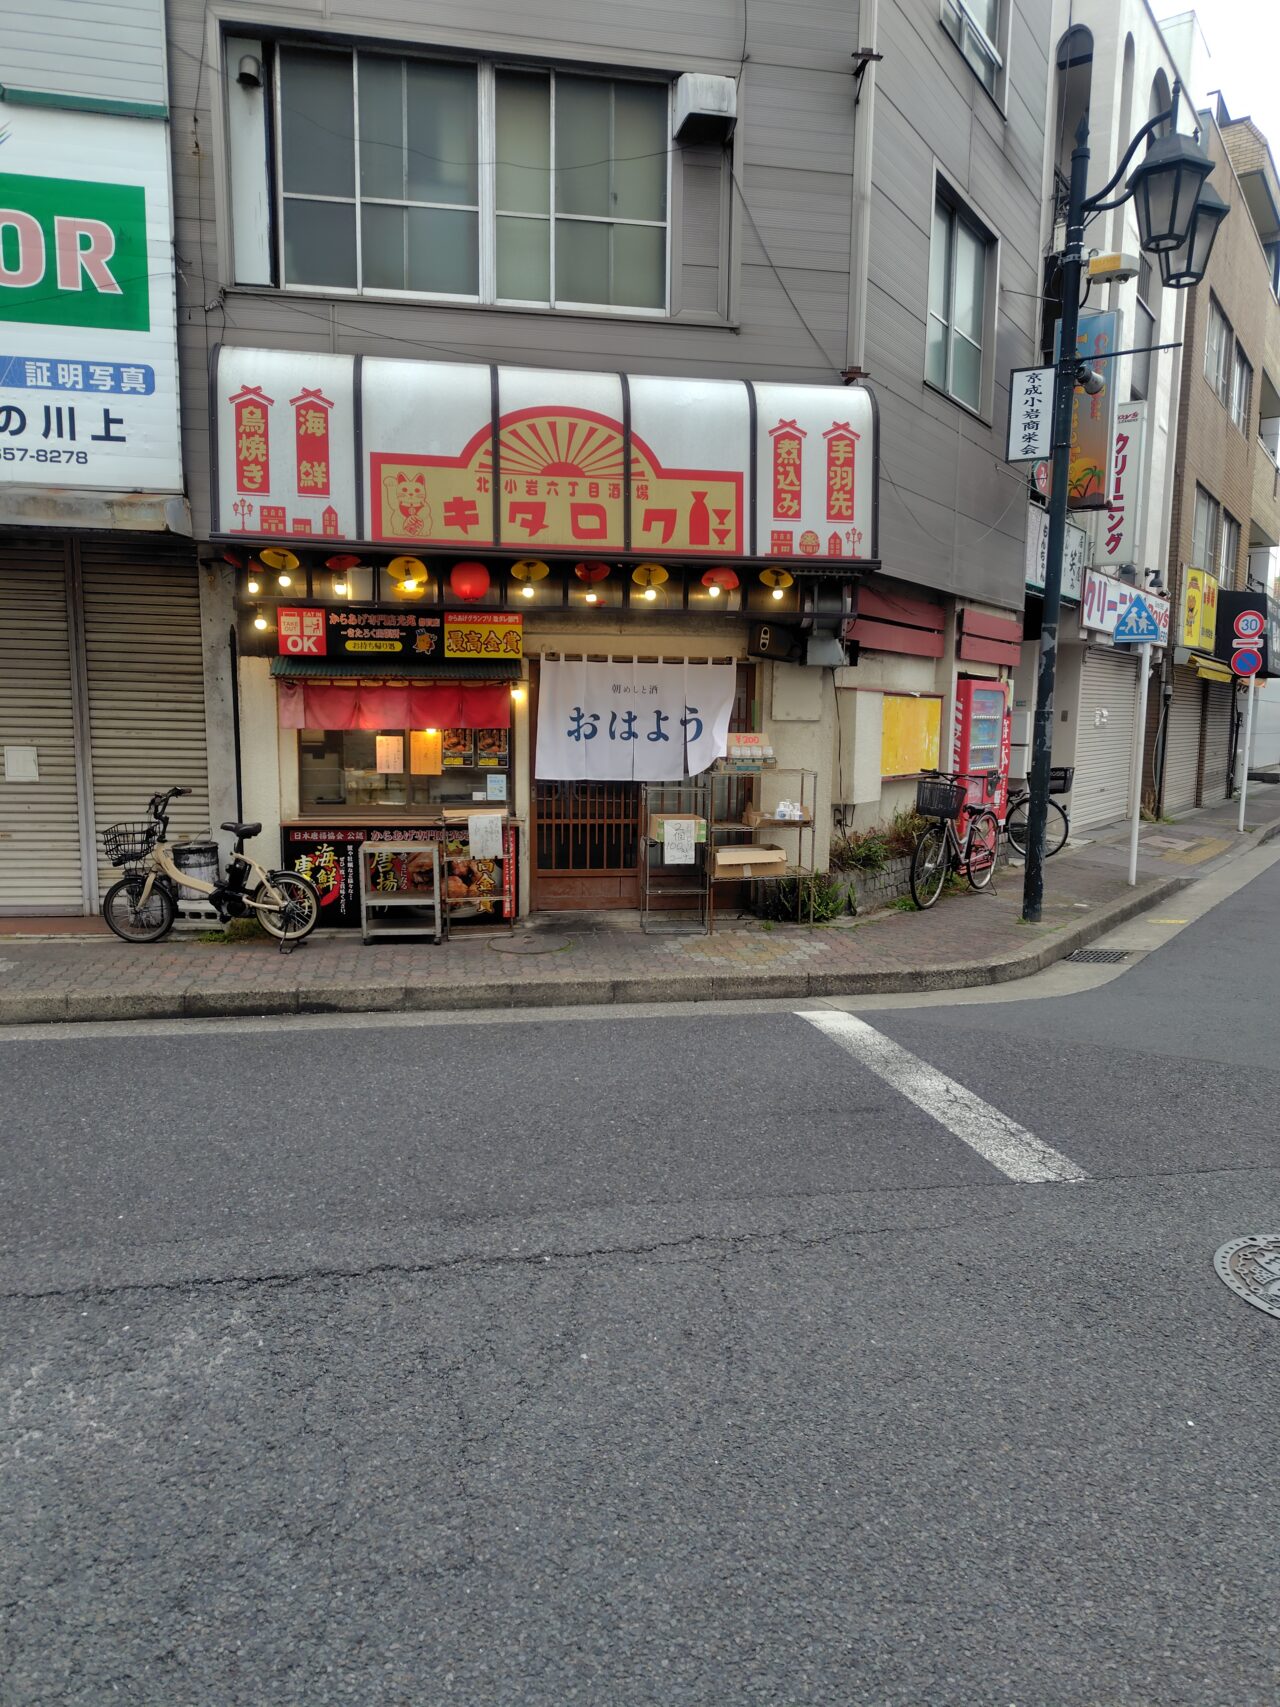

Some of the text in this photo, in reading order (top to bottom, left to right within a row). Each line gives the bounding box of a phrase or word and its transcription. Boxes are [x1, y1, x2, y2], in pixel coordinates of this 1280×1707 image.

[0, 208, 123, 295] OR
[25, 361, 146, 393] 証明写真
[0, 404, 127, 443] の川上
[1020, 373, 1042, 455] 京成小岩商栄会
[0, 447, 88, 465] 57-8278
[239, 406, 266, 489] 鳥焼き
[299, 409, 327, 489] 海鮮
[476, 476, 649, 500] 北小岩六丁目酒場
[777, 439, 800, 516] 煮込み
[829, 439, 854, 516] 手羽先
[1105, 433, 1129, 555] クリーニング
[443, 496, 678, 545] キタロク
[286, 636, 319, 652] OK
[447, 630, 521, 654] 最高金賞
[1241, 619, 1258, 631] 30
[612, 684, 658, 694] 朝めしと酒
[567, 706, 704, 745] おはよう
[315, 843, 338, 891] 海鮮
[475, 857, 498, 913] 高金賞
